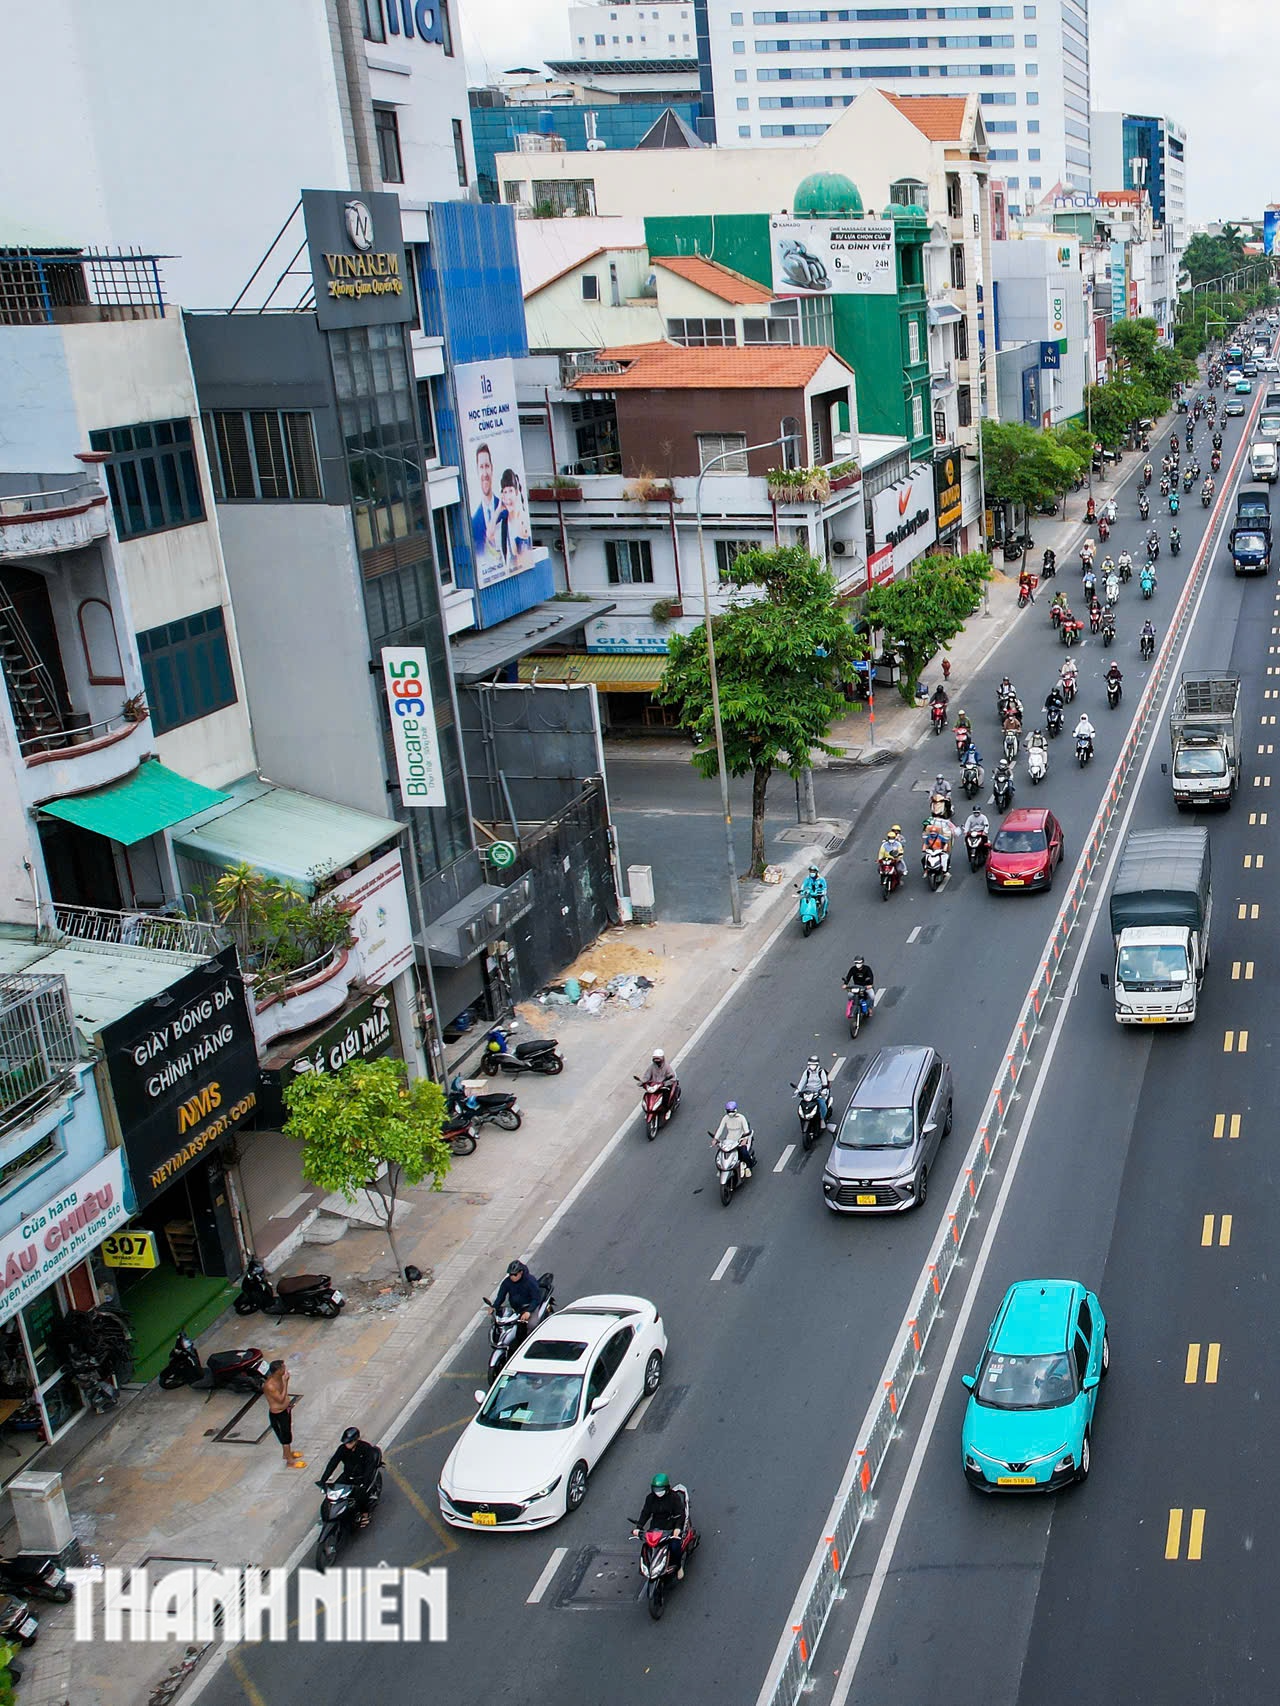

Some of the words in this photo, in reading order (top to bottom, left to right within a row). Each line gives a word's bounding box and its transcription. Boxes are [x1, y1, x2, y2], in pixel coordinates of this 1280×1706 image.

[1054, 191, 1143, 208] mobifone
[847, 242, 870, 250] ĐÌNH
[872, 243, 892, 252] VIỆT
[323, 253, 399, 277] VINAREM
[834, 257, 842, 268] 6
[856, 272, 872, 281] 0%
[1053, 298, 1062, 320] OCB
[1044, 355, 1057, 363] PNJ
[480, 374, 492, 394] ila
[468, 409, 481, 422] HỌC
[482, 404, 498, 418] TIẾNG
[498, 403, 510, 415] ANH
[478, 420, 494, 431] CÙNG
[596, 637, 629, 645] GIA
[133, 1027, 169, 1066] GIÀY
[172, 1000, 213, 1041] BÓNG
[214, 981, 235, 1011] ĐÁ
[330, 1027, 361, 1070] GIỚI
[147, 1053, 193, 1097] CHÍNH
[178, 1082, 222, 1134] NMS
[22, 1216, 47, 1240] Cửa
[48, 1191, 78, 1220] hàng
[21, 1269, 42, 1292] kinh
[42, 1247, 70, 1273] doanh
[70, 1233, 87, 1252] phụ
[87, 1215, 107, 1237] tùng
[104, 1236, 147, 1255] 307
